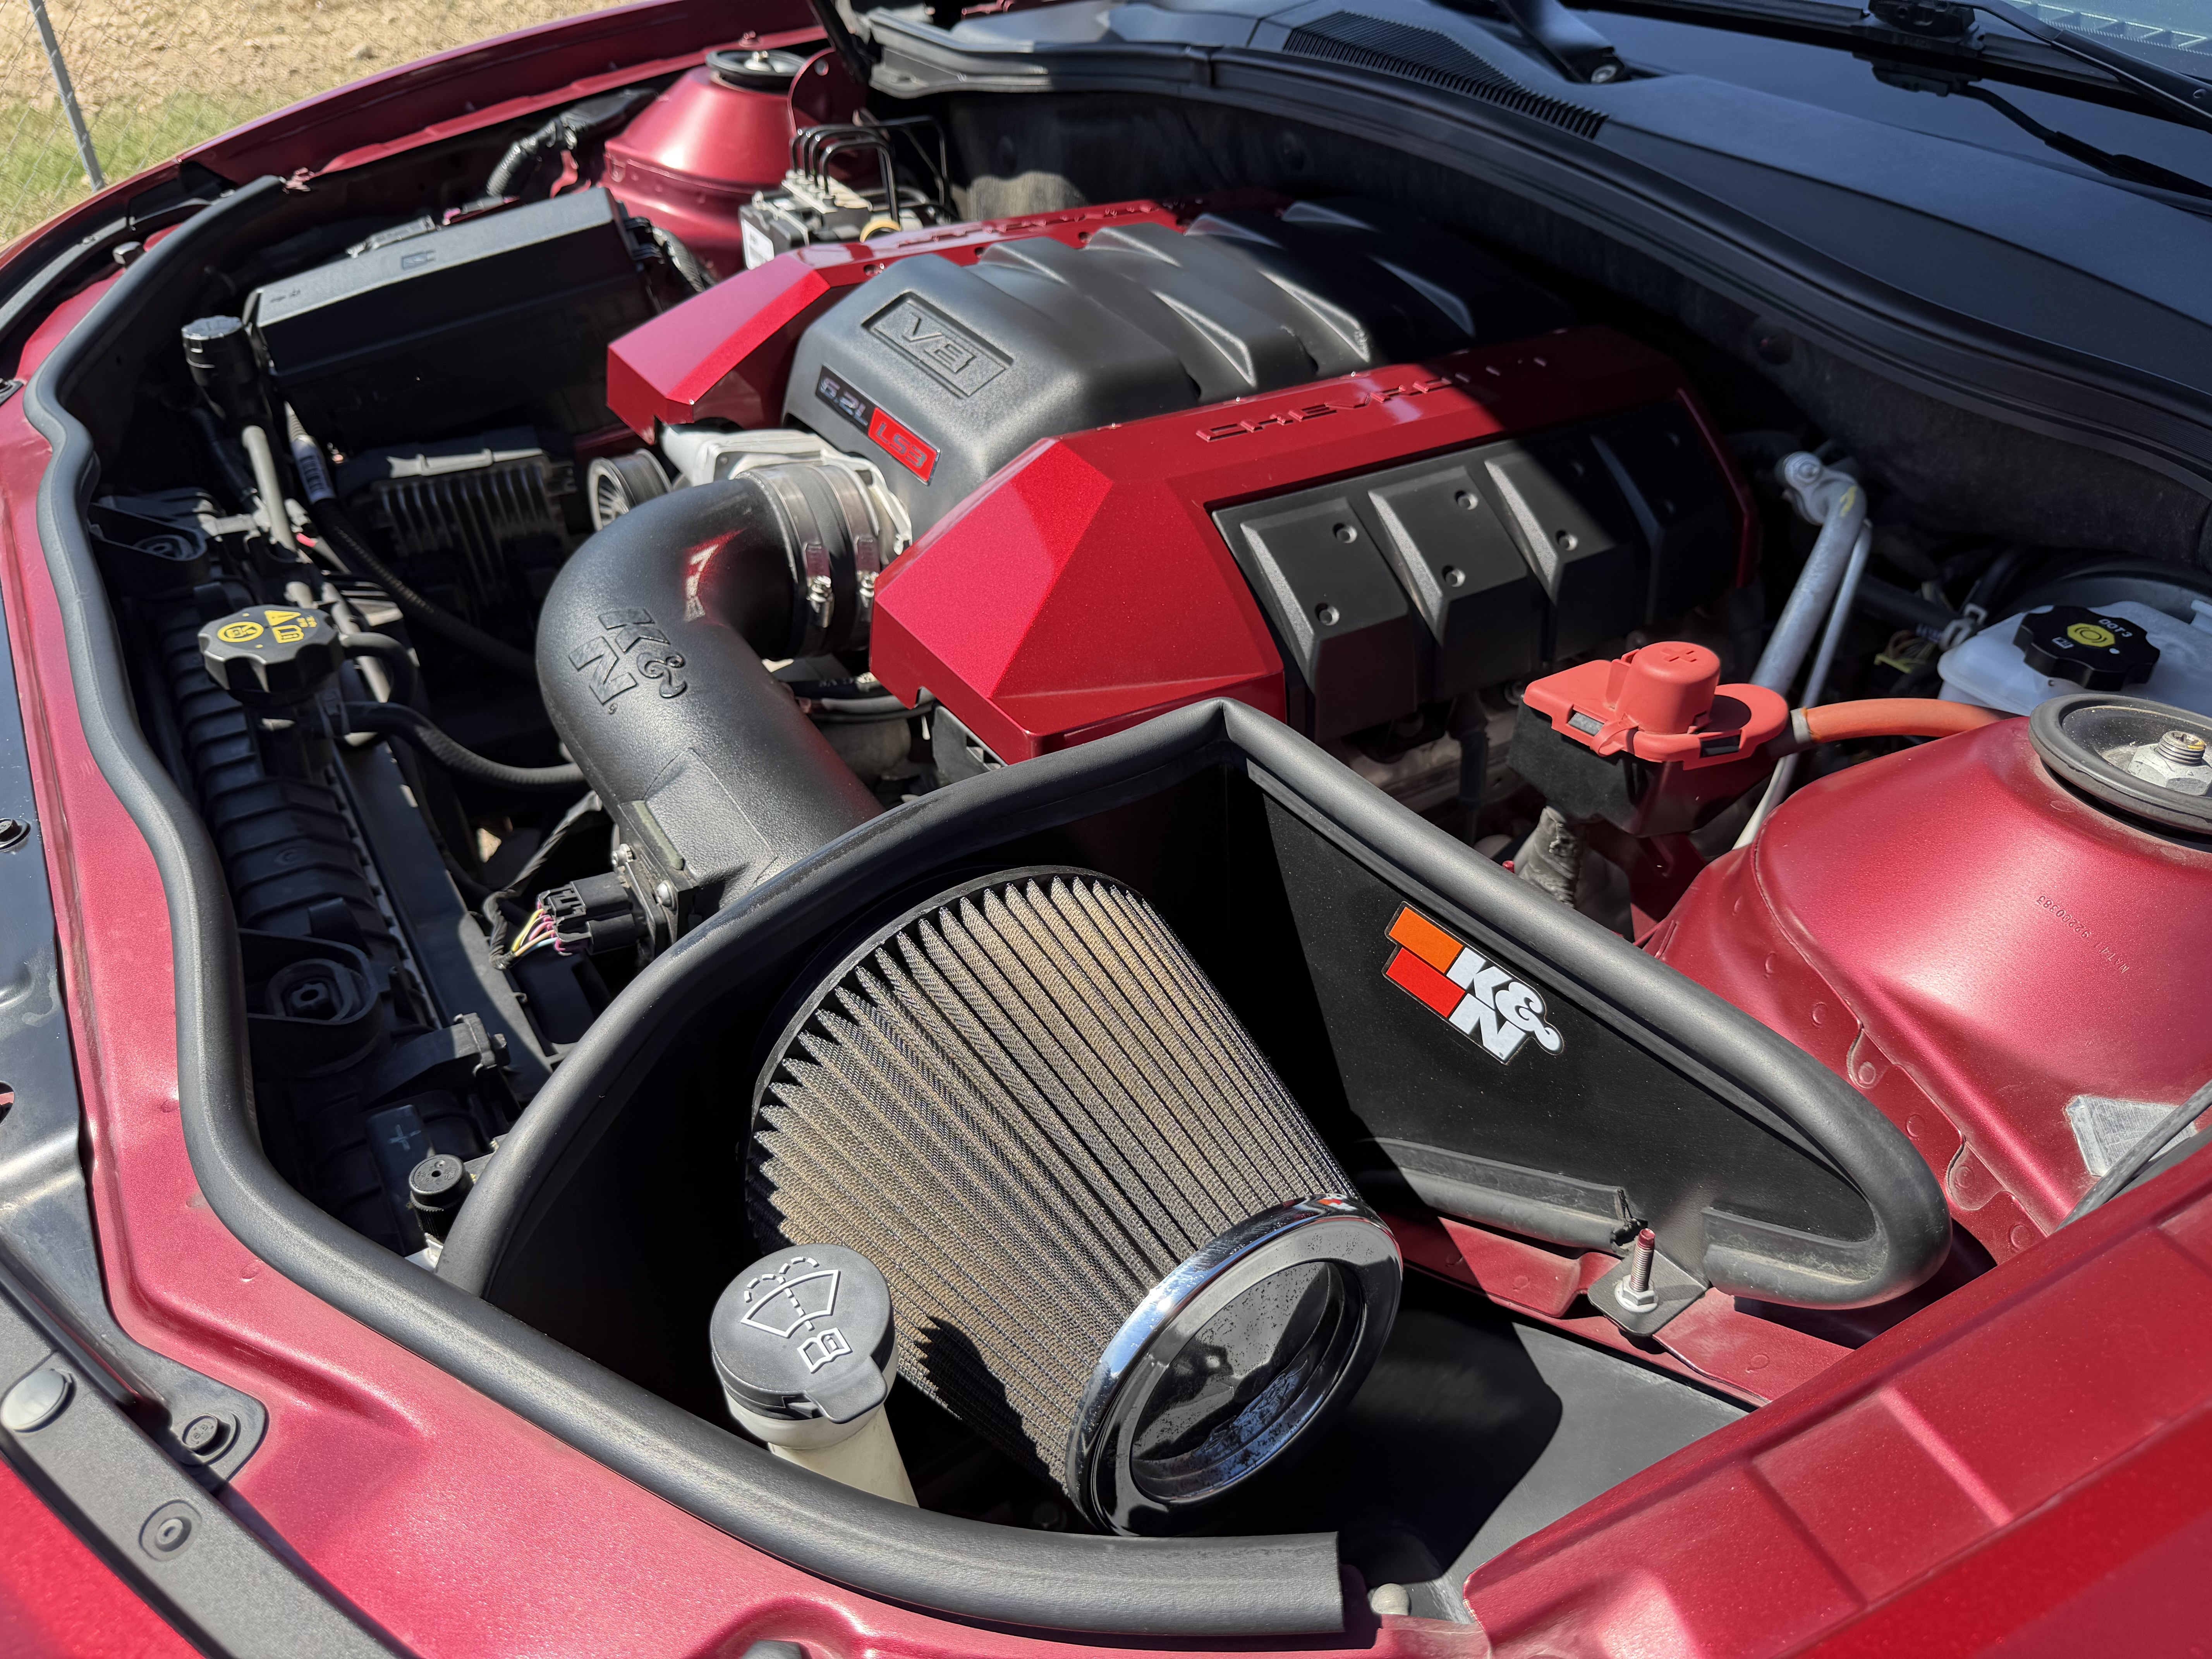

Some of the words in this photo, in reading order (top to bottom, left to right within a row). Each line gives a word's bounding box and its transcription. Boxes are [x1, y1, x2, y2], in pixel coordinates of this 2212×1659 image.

[901, 311, 977, 374] V8
[876, 422, 927, 468] LS3
[1446, 947, 1561, 1060] K&N
